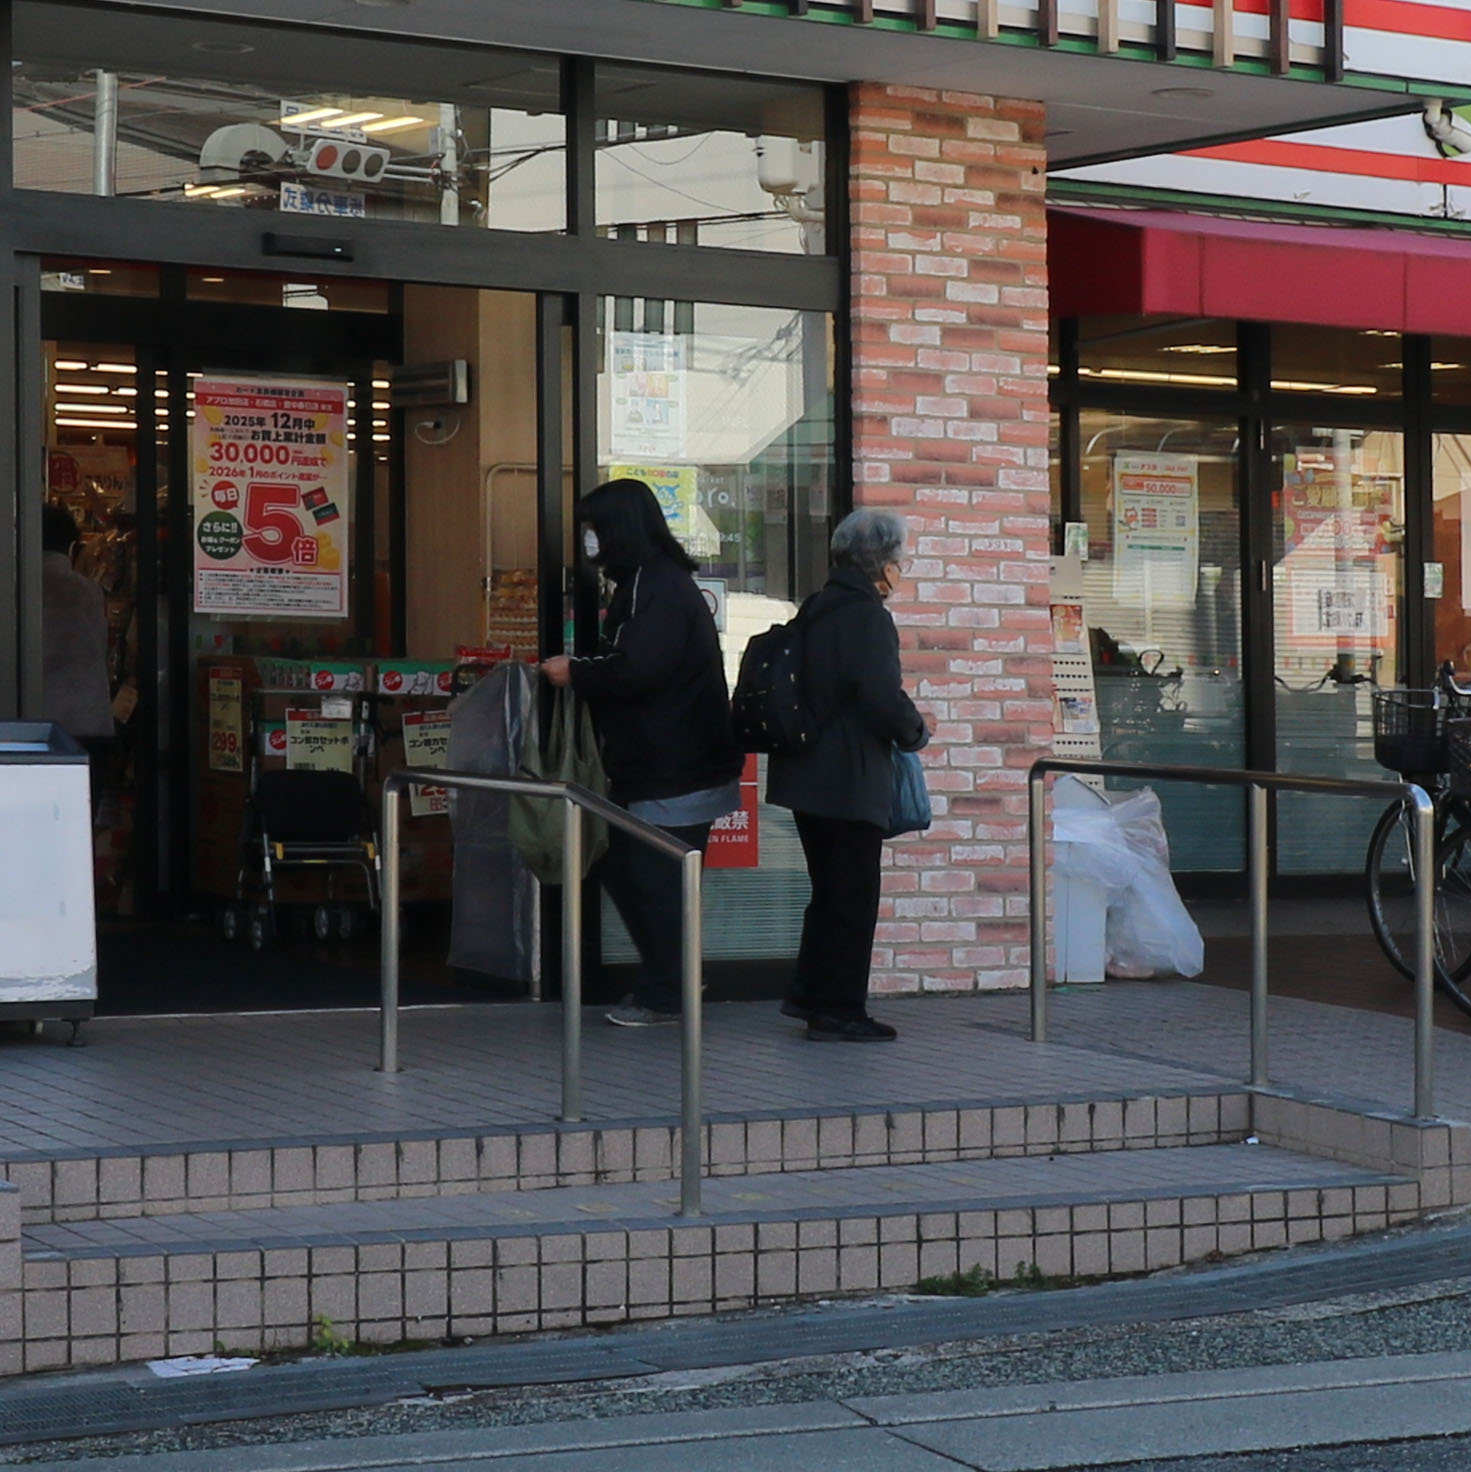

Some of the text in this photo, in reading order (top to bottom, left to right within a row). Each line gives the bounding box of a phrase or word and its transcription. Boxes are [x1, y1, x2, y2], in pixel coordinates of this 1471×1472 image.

[224, 412, 315, 430] 2025年 12月中
[209, 442, 290, 465] 30,000
[209, 466, 246, 477] 2026年
[720, 834, 749, 843] FLAME
